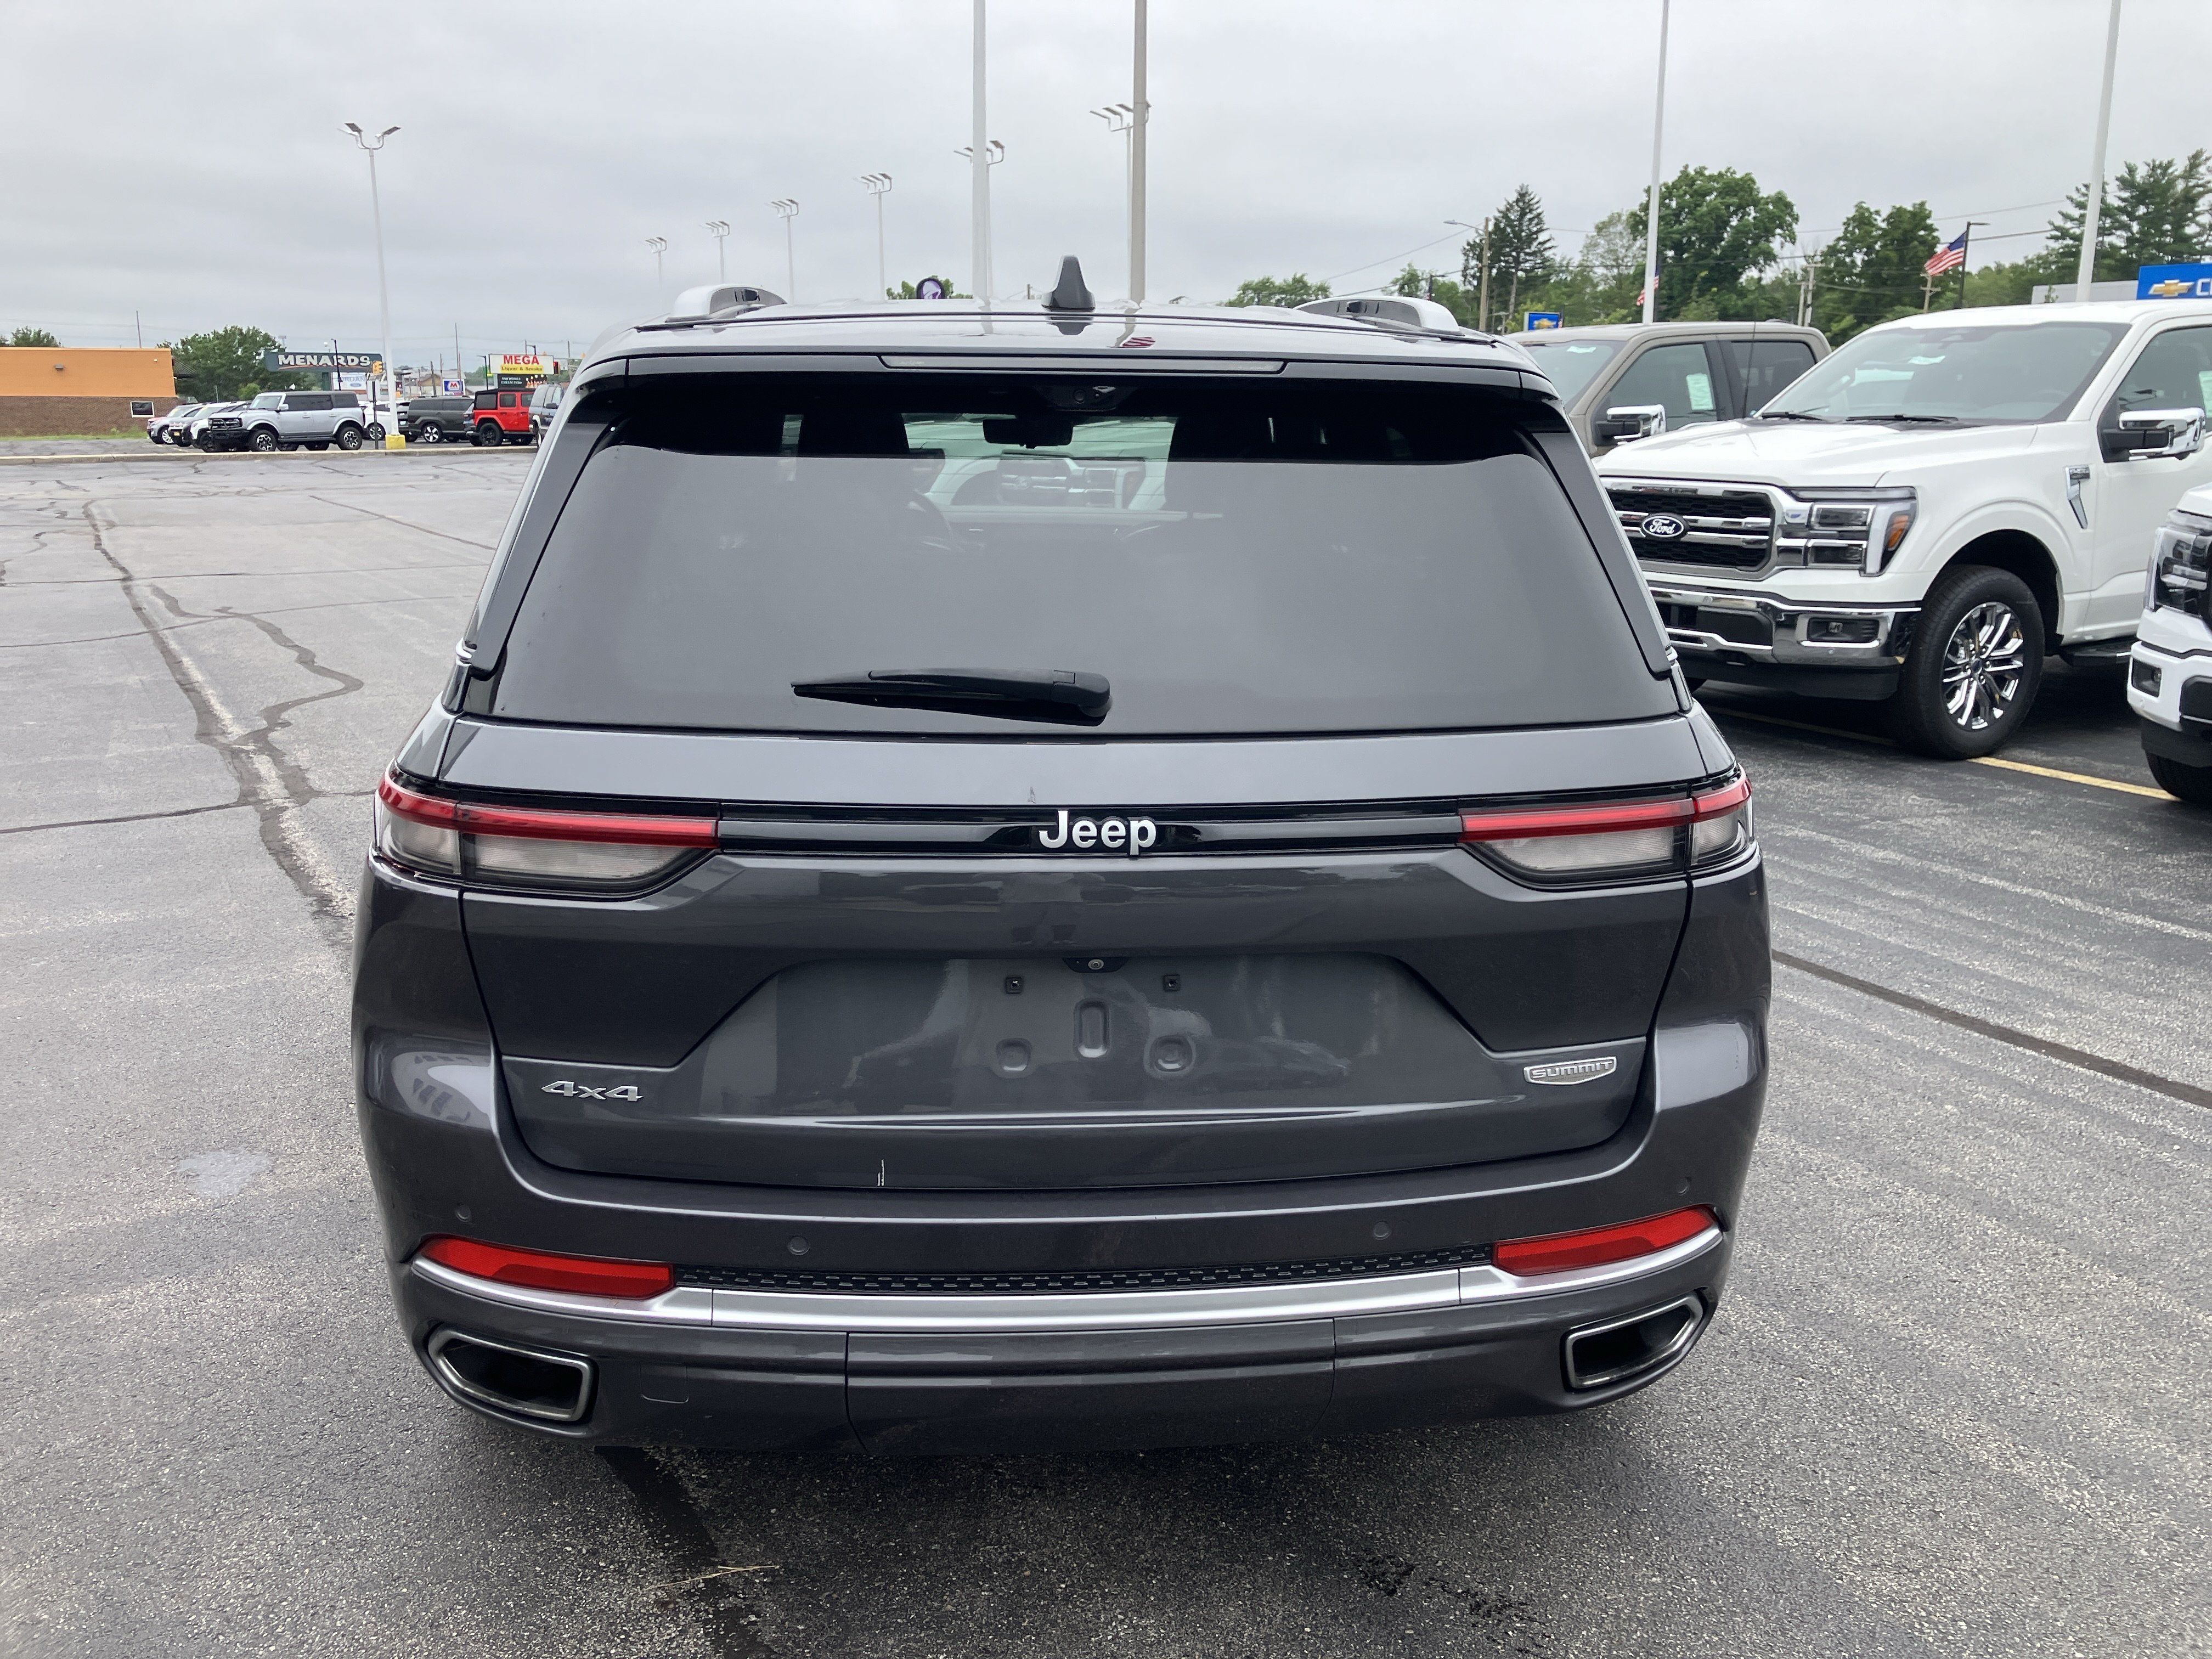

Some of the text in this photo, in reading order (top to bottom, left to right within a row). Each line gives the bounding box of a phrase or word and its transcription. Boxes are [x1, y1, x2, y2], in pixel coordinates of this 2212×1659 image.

[278, 354, 370, 366] MENARDS
[503, 354, 539, 364] MEGA
[1649, 518, 1677, 534] Ford
[1039, 810, 1156, 855] Jeep
[1532, 1060, 1613, 1079] SUMMIT
[541, 1080, 644, 1102] 4x4
